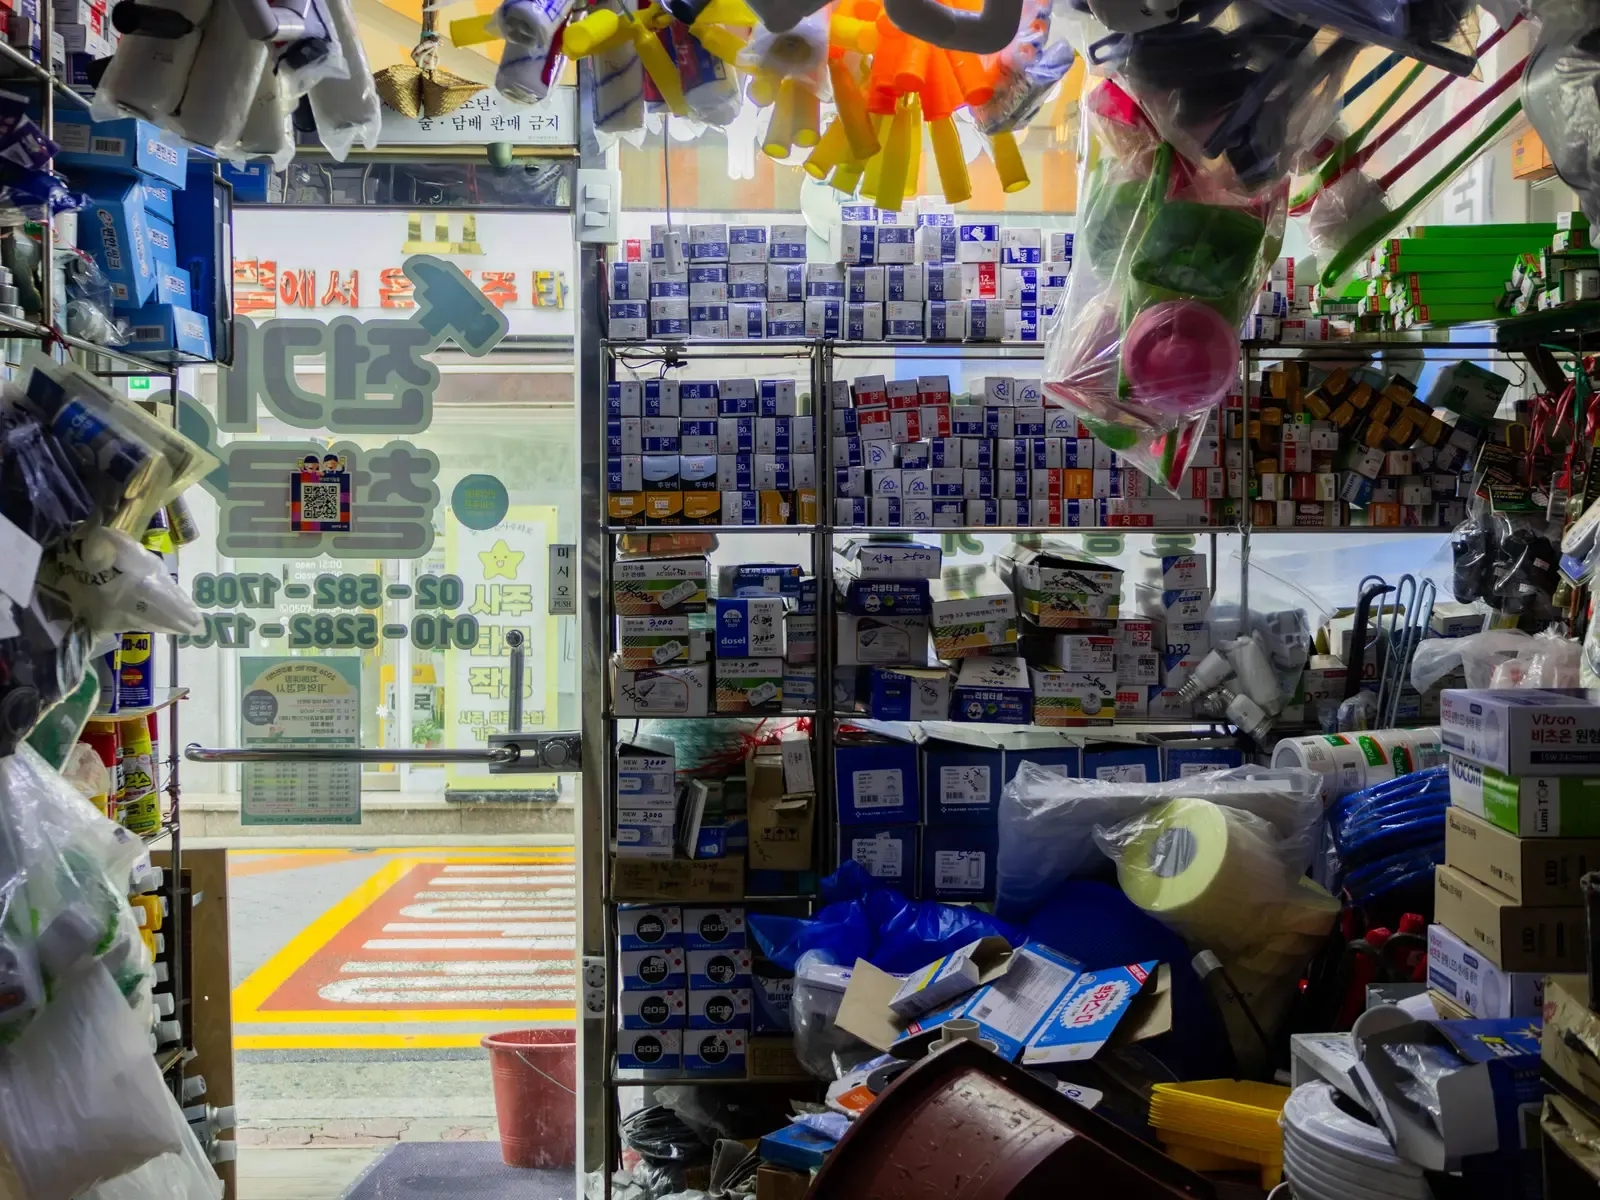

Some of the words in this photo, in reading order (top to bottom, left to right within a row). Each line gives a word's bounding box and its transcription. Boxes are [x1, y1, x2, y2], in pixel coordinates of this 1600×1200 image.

[419, 116, 433, 131] 술
[451, 116, 482, 131] 담배
[490, 116, 521, 131] 판매
[528, 116, 559, 131] 금지
[557, 547, 570, 596] 미시오
[468, 584, 533, 616] 사주
[553, 600, 572, 608] PUSH
[721, 636, 746, 645] dosel
[1531, 729, 1573, 744] 비츠온
[1537, 808, 1548, 833] Lumi
[703, 924, 725, 932] 205
[642, 966, 665, 974] 205
[643, 1006, 666, 1014] 205
[637, 1045, 660, 1053] 205
[702, 1045, 725, 1053] 205
